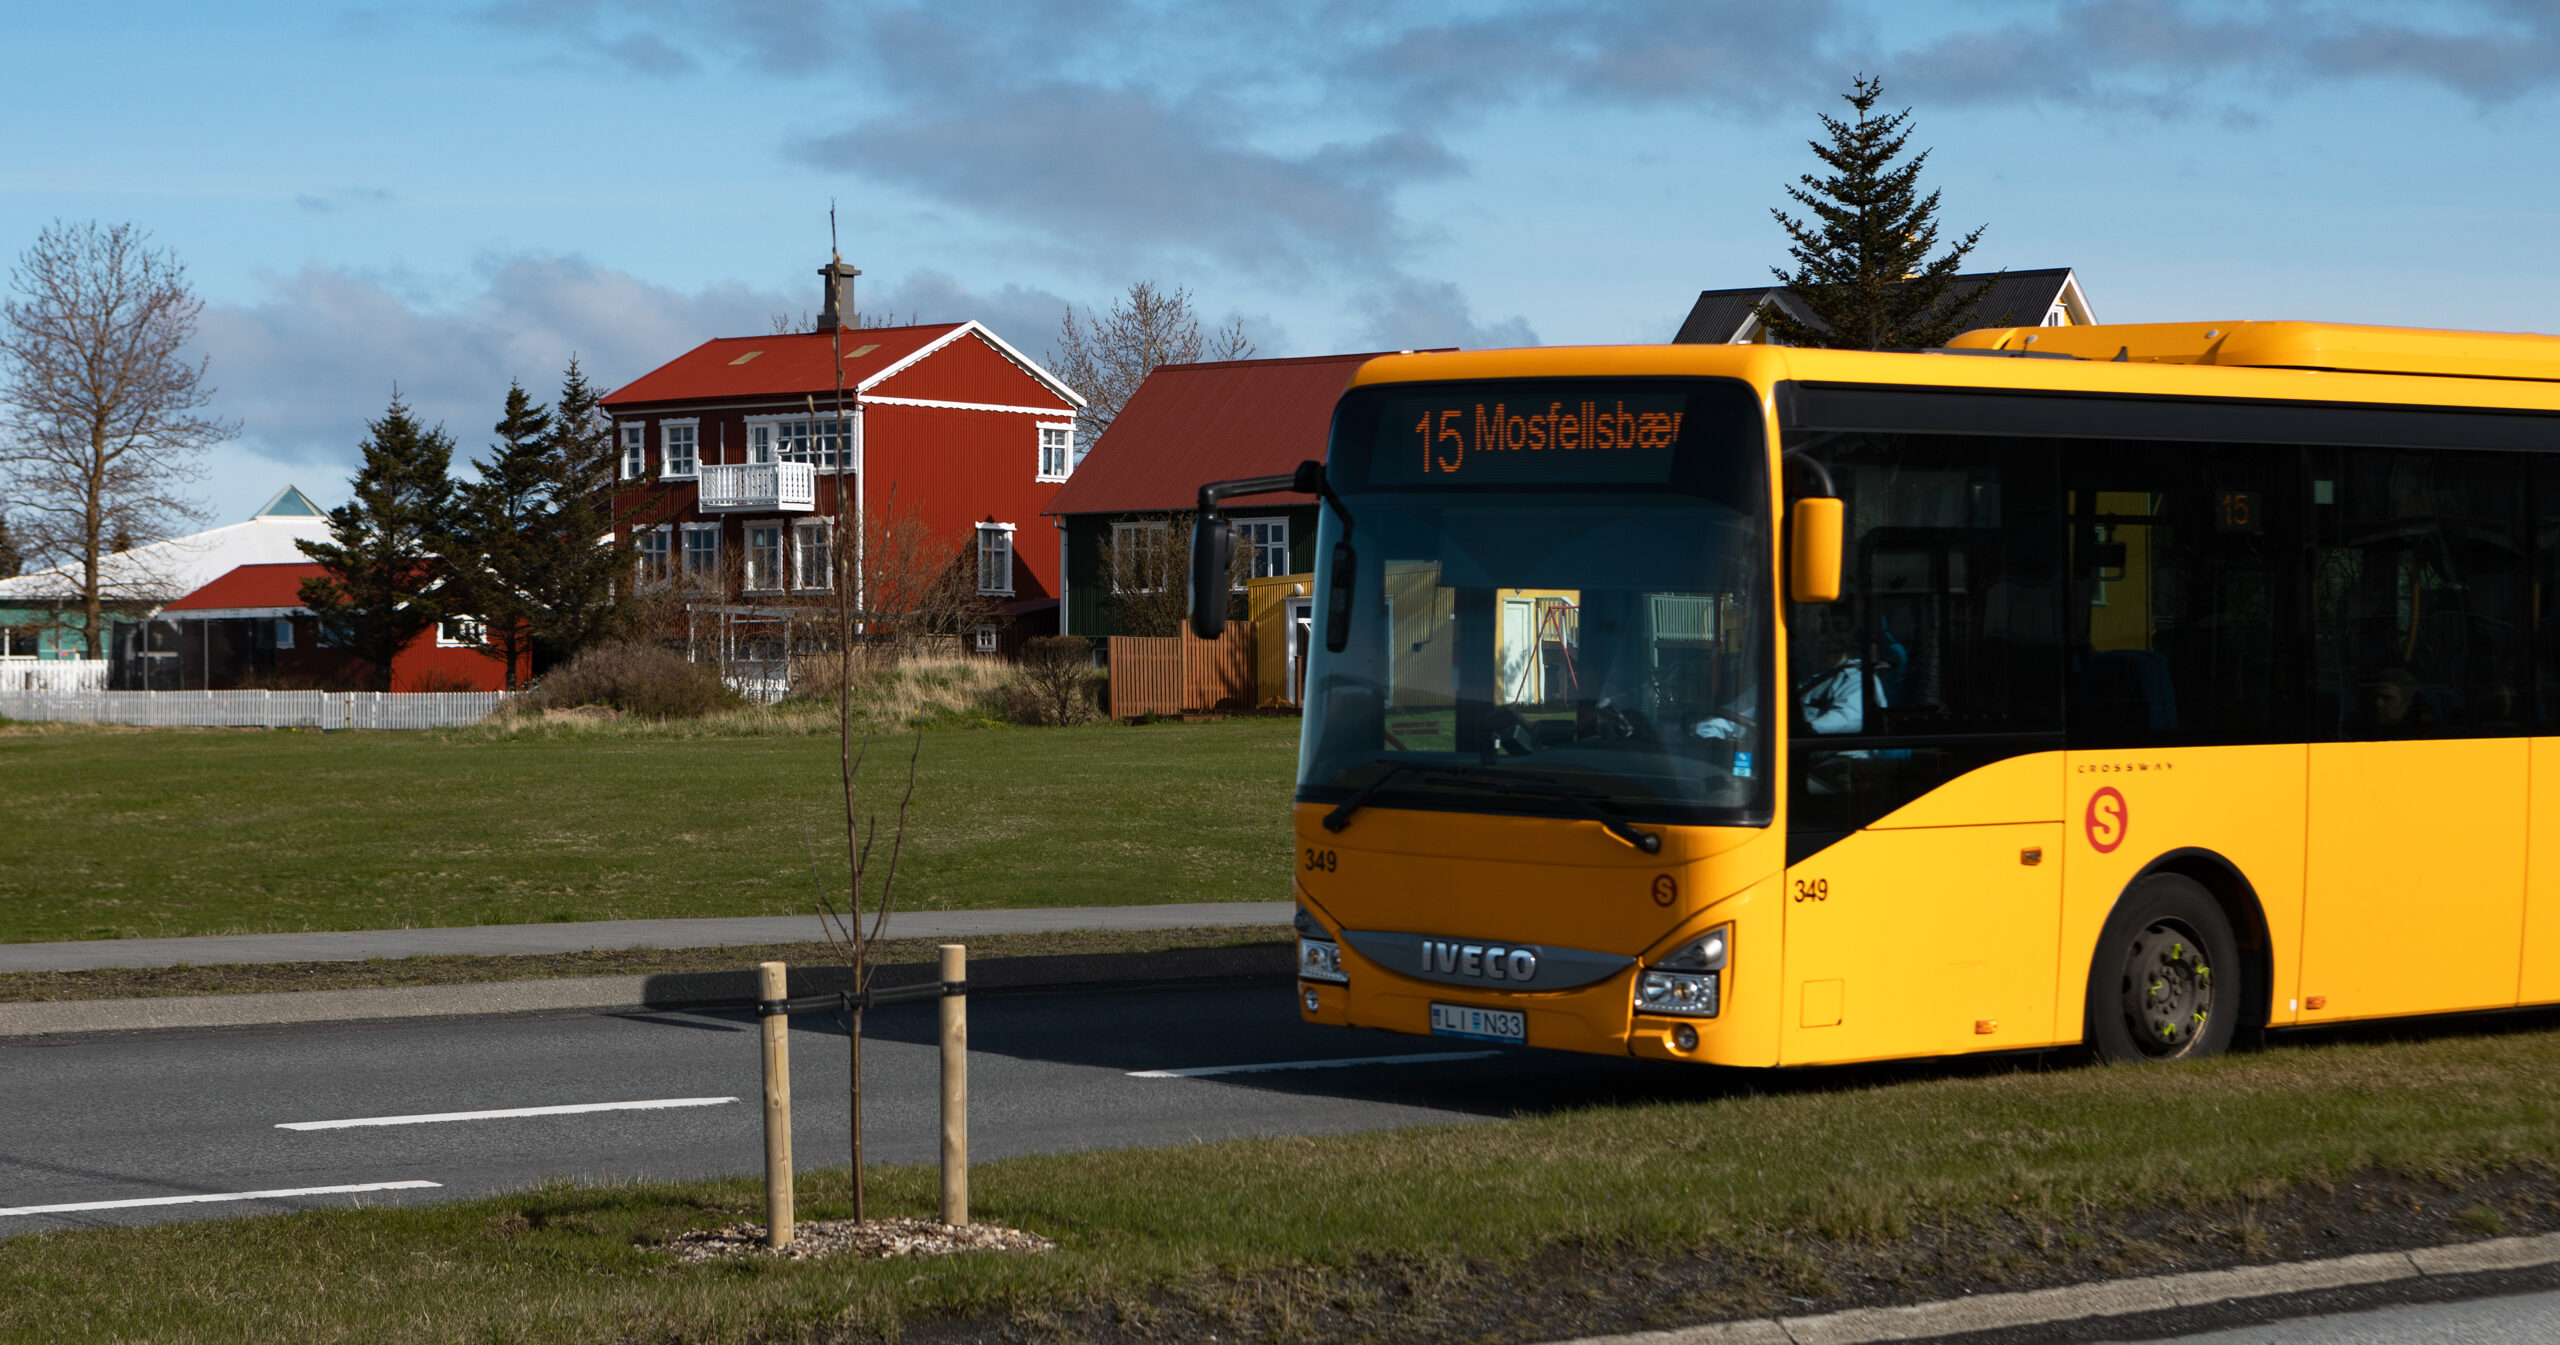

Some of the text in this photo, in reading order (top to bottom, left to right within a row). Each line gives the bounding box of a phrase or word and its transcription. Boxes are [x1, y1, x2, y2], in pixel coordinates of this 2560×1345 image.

[1415, 411, 1464, 473] 15
[2223, 494, 2249, 525] 15
[2077, 762, 2174, 774] CROSSWAY
[2089, 790, 2124, 850] S
[1304, 847, 1338, 873] 349
[1793, 878, 1828, 903] 349
[1422, 940, 1537, 981] IVECO
